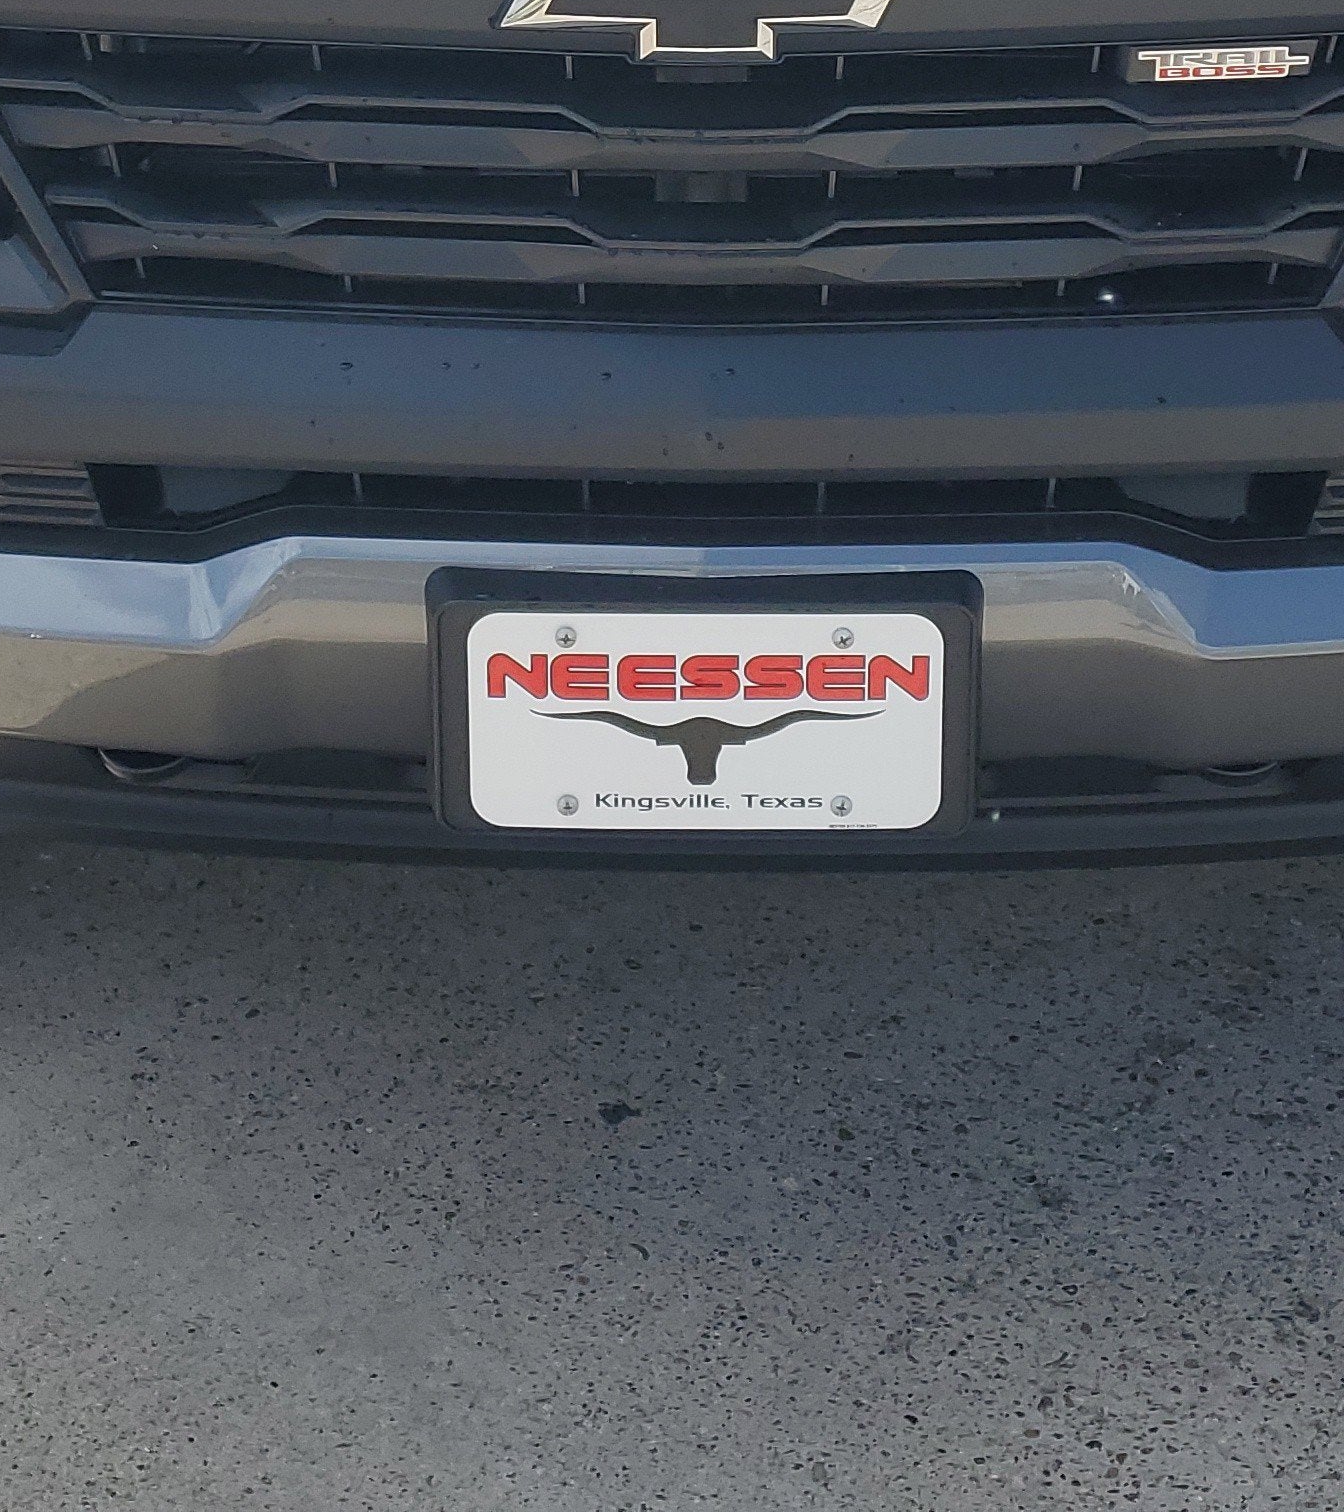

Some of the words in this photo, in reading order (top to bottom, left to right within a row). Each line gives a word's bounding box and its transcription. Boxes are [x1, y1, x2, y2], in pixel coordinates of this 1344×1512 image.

[1138, 46, 1310, 67] TRAIL
[1156, 63, 1290, 81] BOSS
[486, 653, 930, 702] NEESSEN
[594, 793, 731, 812] Kingsville,
[741, 794, 824, 809] Texas
